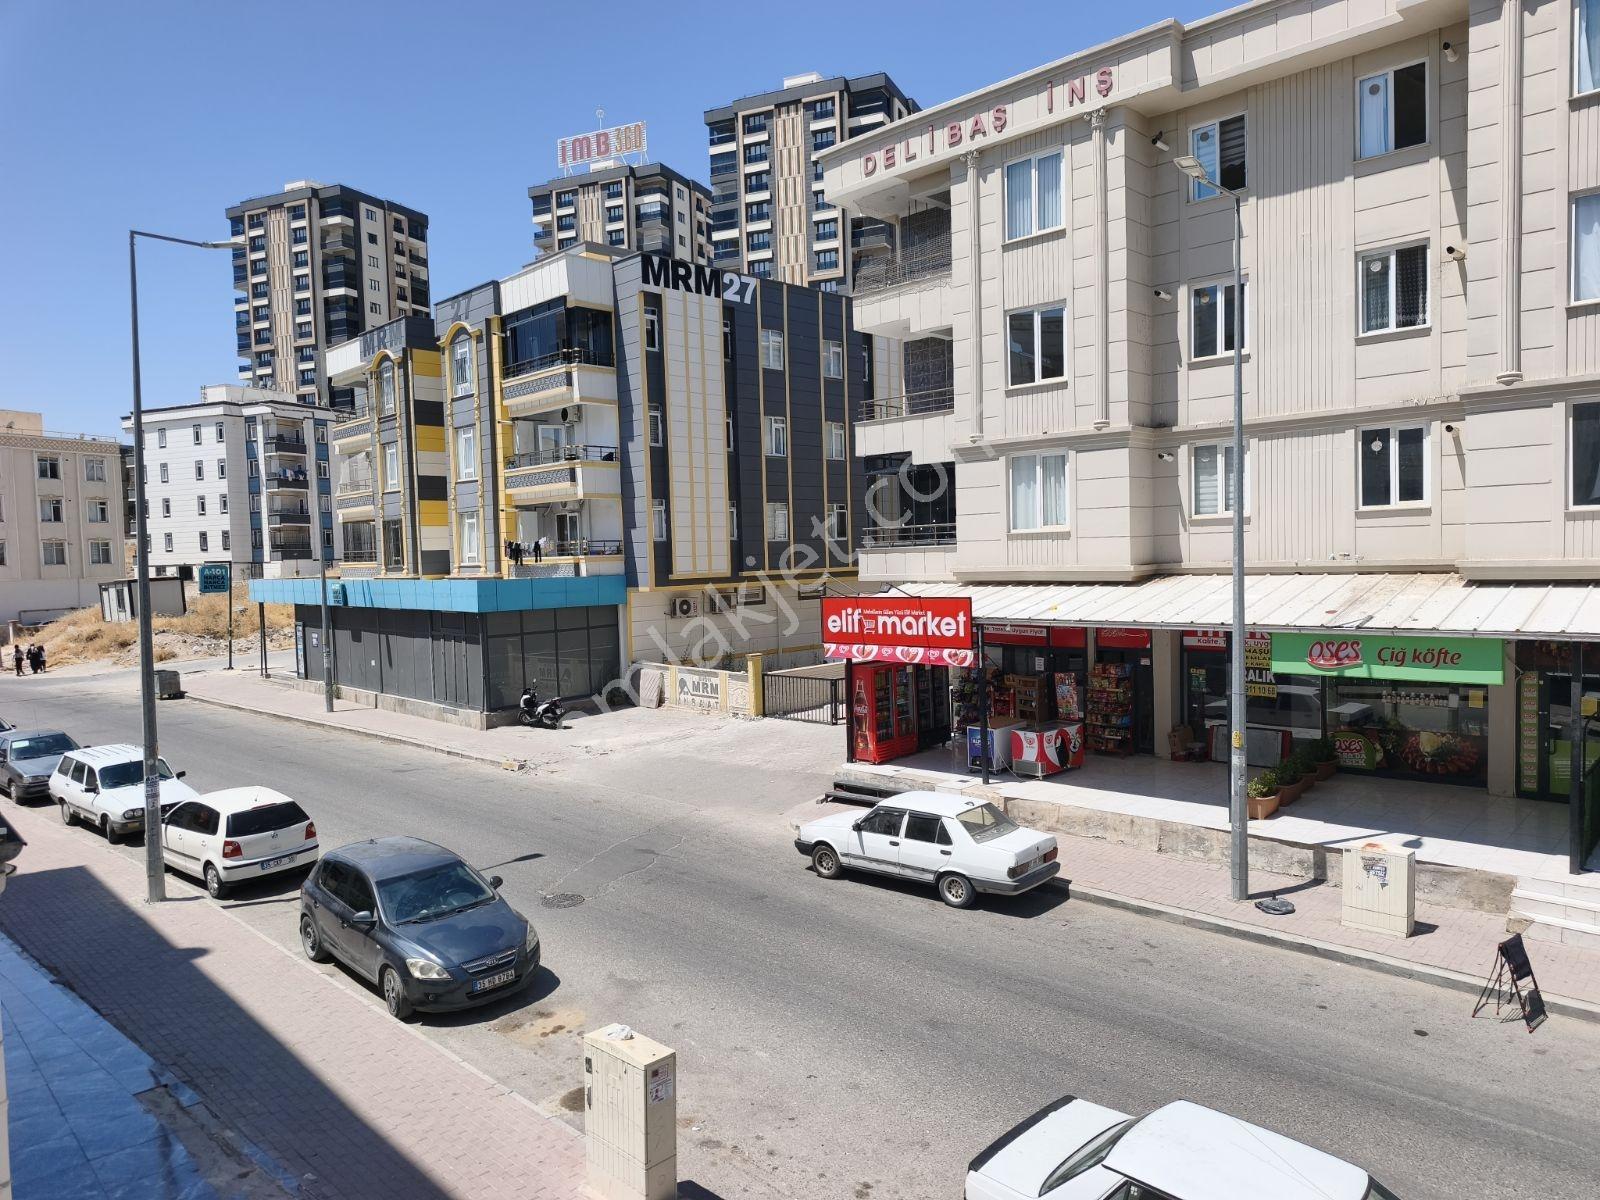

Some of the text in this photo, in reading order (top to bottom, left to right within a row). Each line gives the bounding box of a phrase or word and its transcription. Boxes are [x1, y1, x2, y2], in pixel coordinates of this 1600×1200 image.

[863, 67, 1112, 174] DELİBAŞ İNŞ
[827, 608, 966, 637] elif market
[1377, 646, 1407, 667] Çiğ
[1412, 647, 1462, 669] köfte
